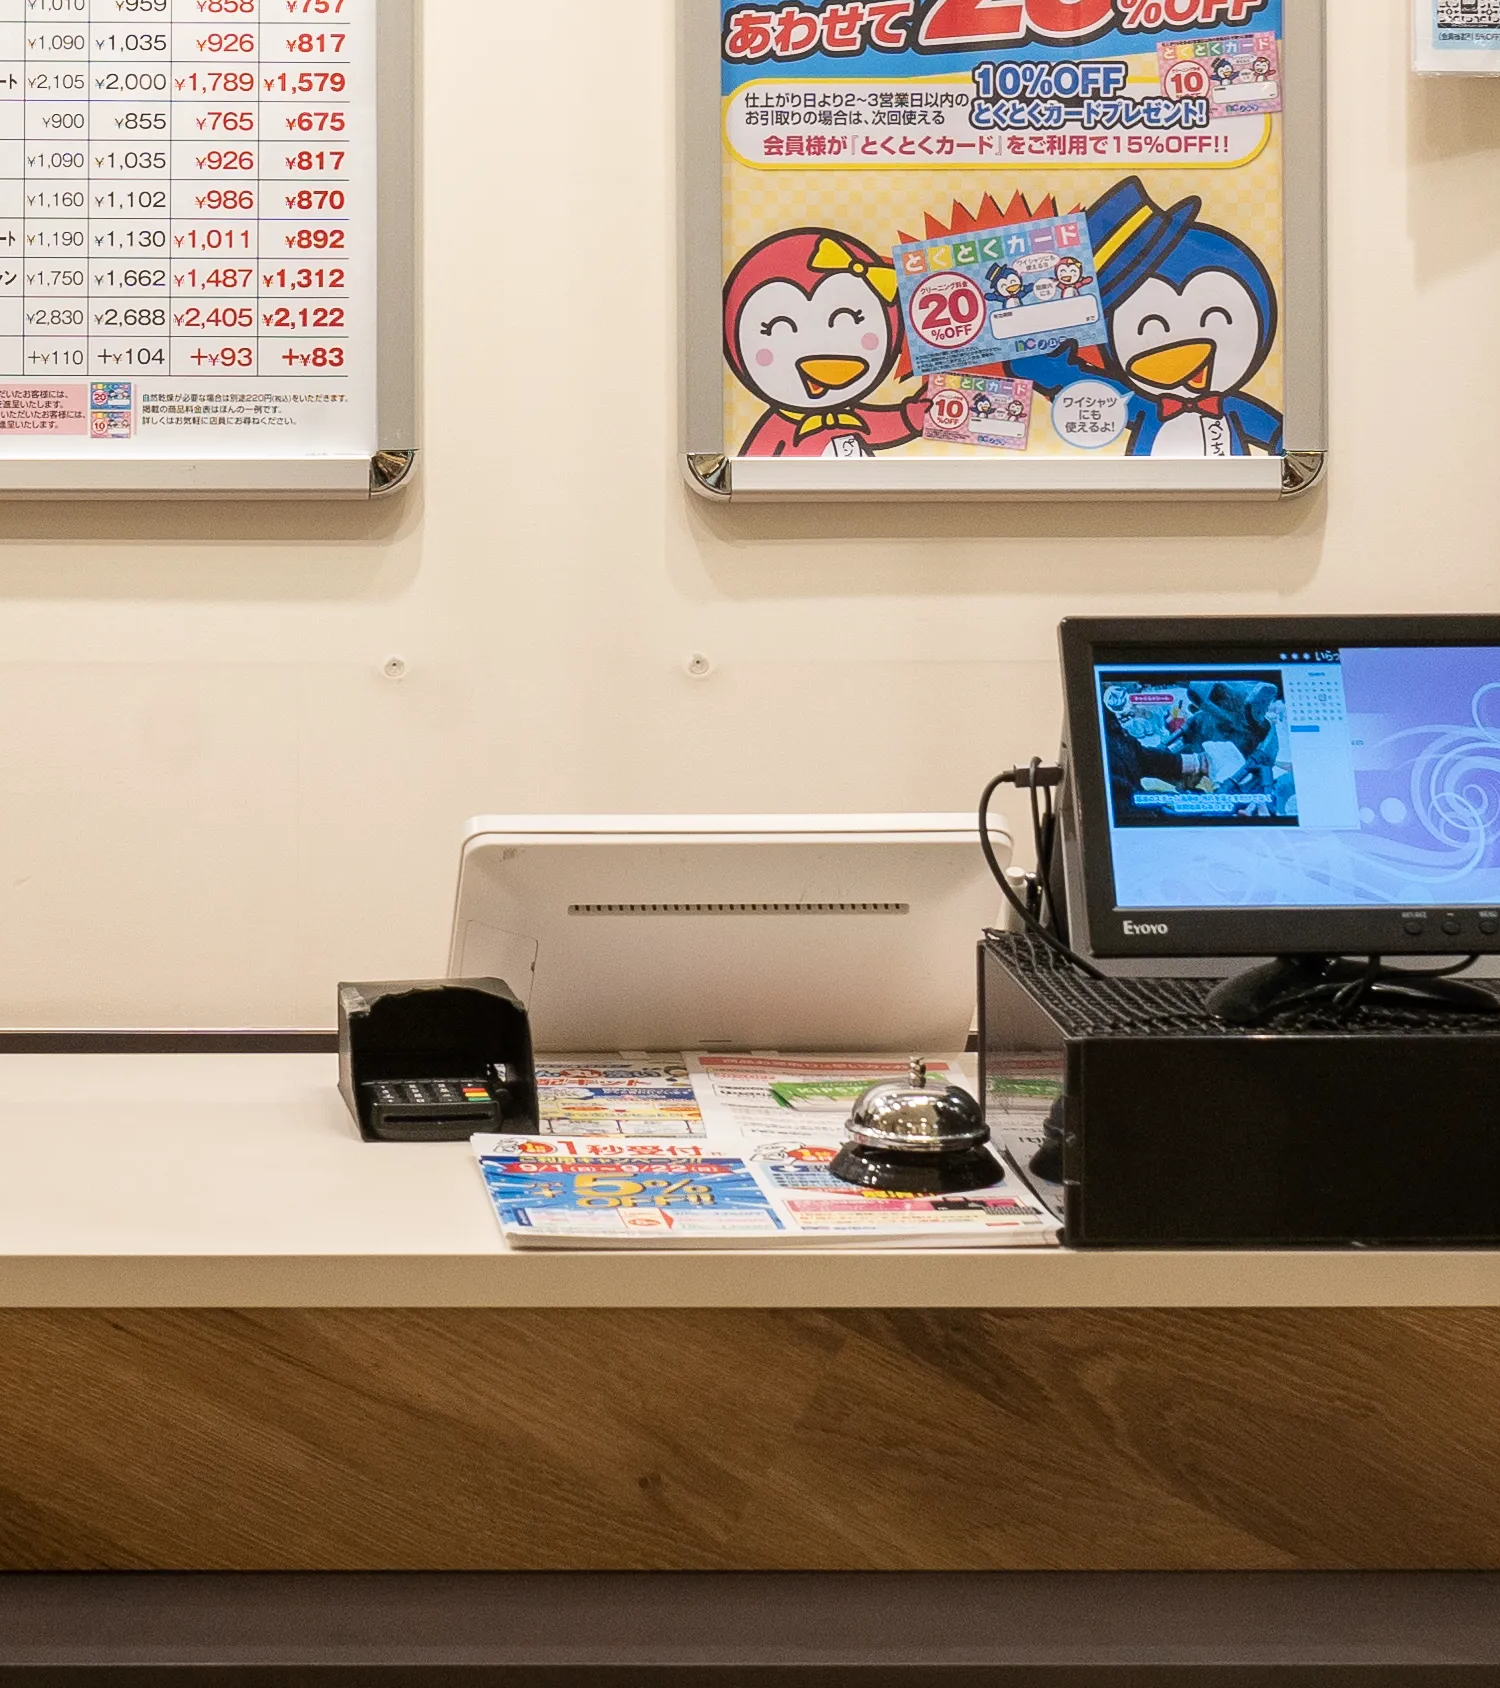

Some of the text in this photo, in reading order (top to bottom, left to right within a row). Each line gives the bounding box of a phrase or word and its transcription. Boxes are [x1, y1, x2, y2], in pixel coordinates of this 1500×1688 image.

[286, 33, 346, 53] ¥817
[263, 72, 346, 94] ¥1,579
[973, 62, 1127, 98] 10%OFF
[286, 112, 345, 131] ¥675
[745, 110, 946, 126] お引取りの場合は、次回使える
[971, 99, 1208, 130] とくとくカードプレゼント!
[285, 151, 345, 170] ¥817
[285, 190, 345, 210] ¥870
[285, 229, 345, 249] ¥892
[26, 271, 84, 288] ¥1,750
[262, 268, 345, 290] ¥1,312
[262, 307, 345, 329] ¥2,122
[282, 347, 344, 367] +¥83
[1063, 395, 1117, 409] ワイシャツ
[1065, 421, 1115, 434] 使えるよ!
